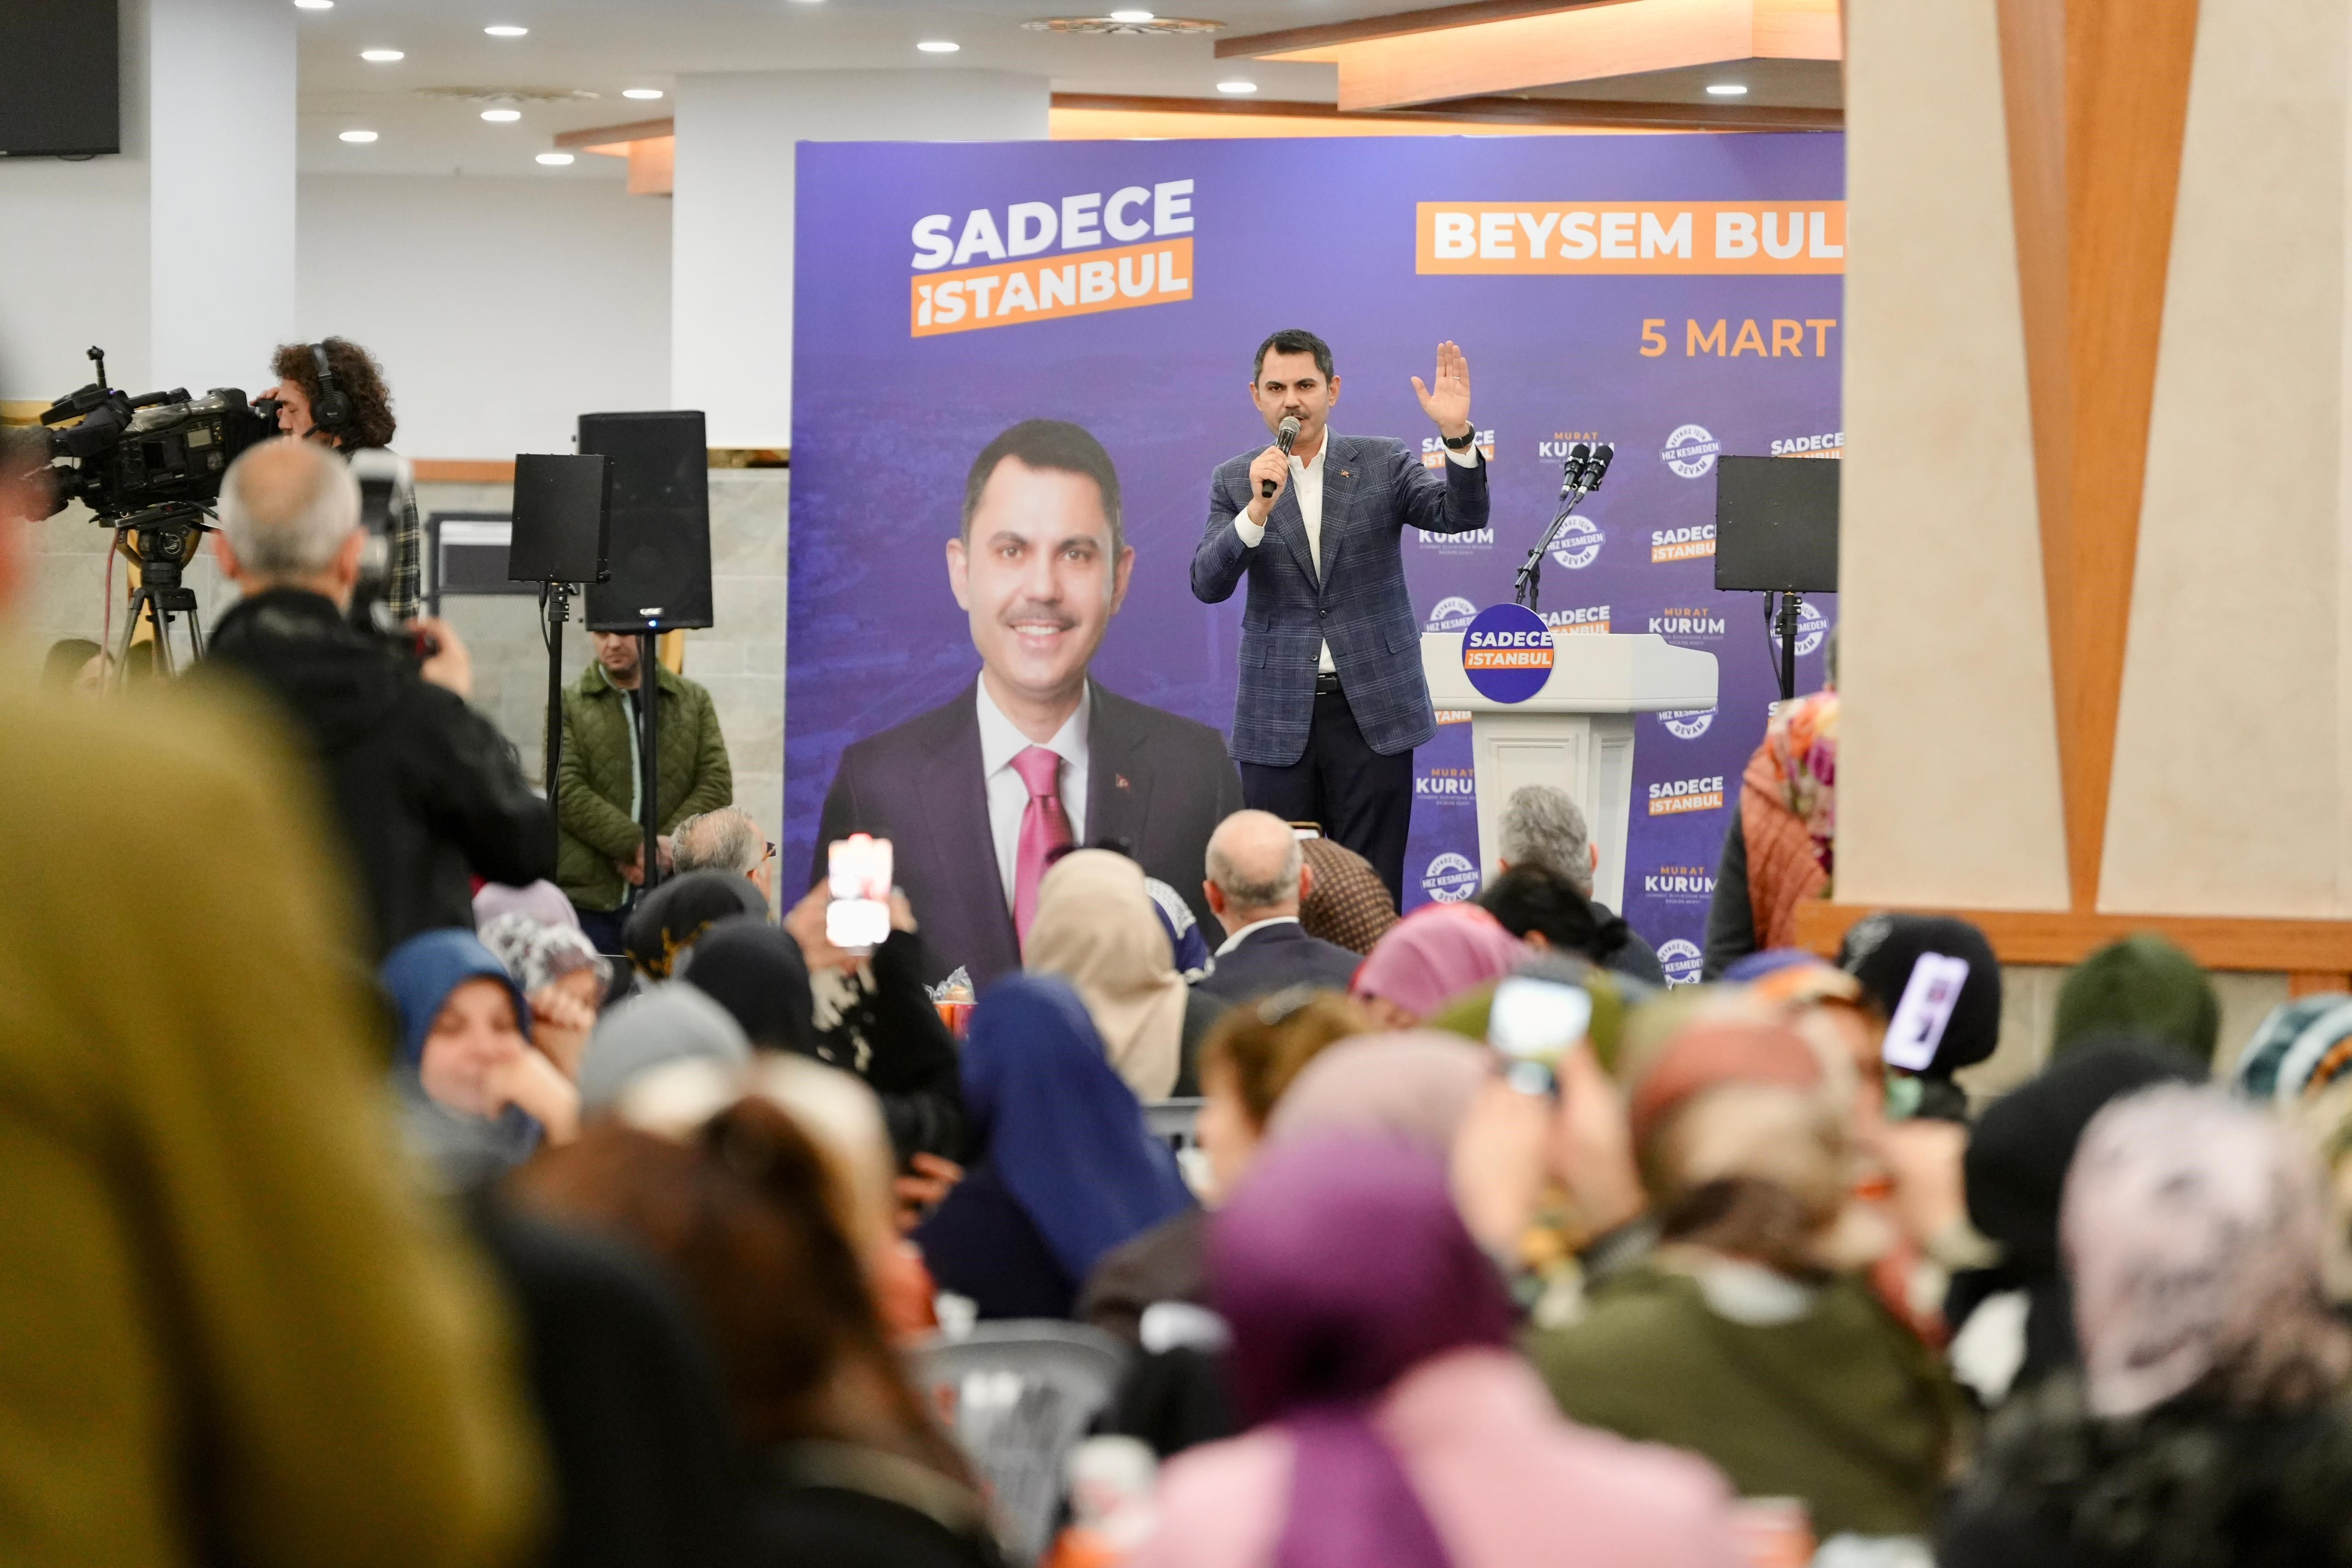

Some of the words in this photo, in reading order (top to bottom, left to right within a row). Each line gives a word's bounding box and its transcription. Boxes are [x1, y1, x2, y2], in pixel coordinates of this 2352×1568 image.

[911, 179, 1194, 270] SADECE
[1434, 212, 1692, 259] BEYSEM
[1715, 211, 1848, 259] BUL
[1639, 319, 1667, 357] 5
[1686, 319, 1837, 357] MART
[1422, 430, 1494, 452] SACE
[1554, 432, 1598, 440] MURAT
[1771, 432, 1845, 455] SADECE
[1661, 450, 1676, 461] HIZ
[1676, 442, 1719, 458] KESMEDEN
[1678, 461, 1707, 474] DEVAM
[1651, 524, 1717, 546] SADEC
[1563, 552, 1591, 565] DEVAM
[1653, 541, 1716, 560] İSTANBU
[1664, 608, 1708, 616] MURAT
[1649, 618, 1724, 634] KURUM
[1470, 632, 1552, 647] SADECE
[1675, 722, 1704, 735] DEVAM
[1431, 768, 1474, 777] MURAT
[1416, 778, 1473, 794] KURU
[1649, 776, 1724, 799] SADECE
[1661, 866, 1705, 874] MURAT
